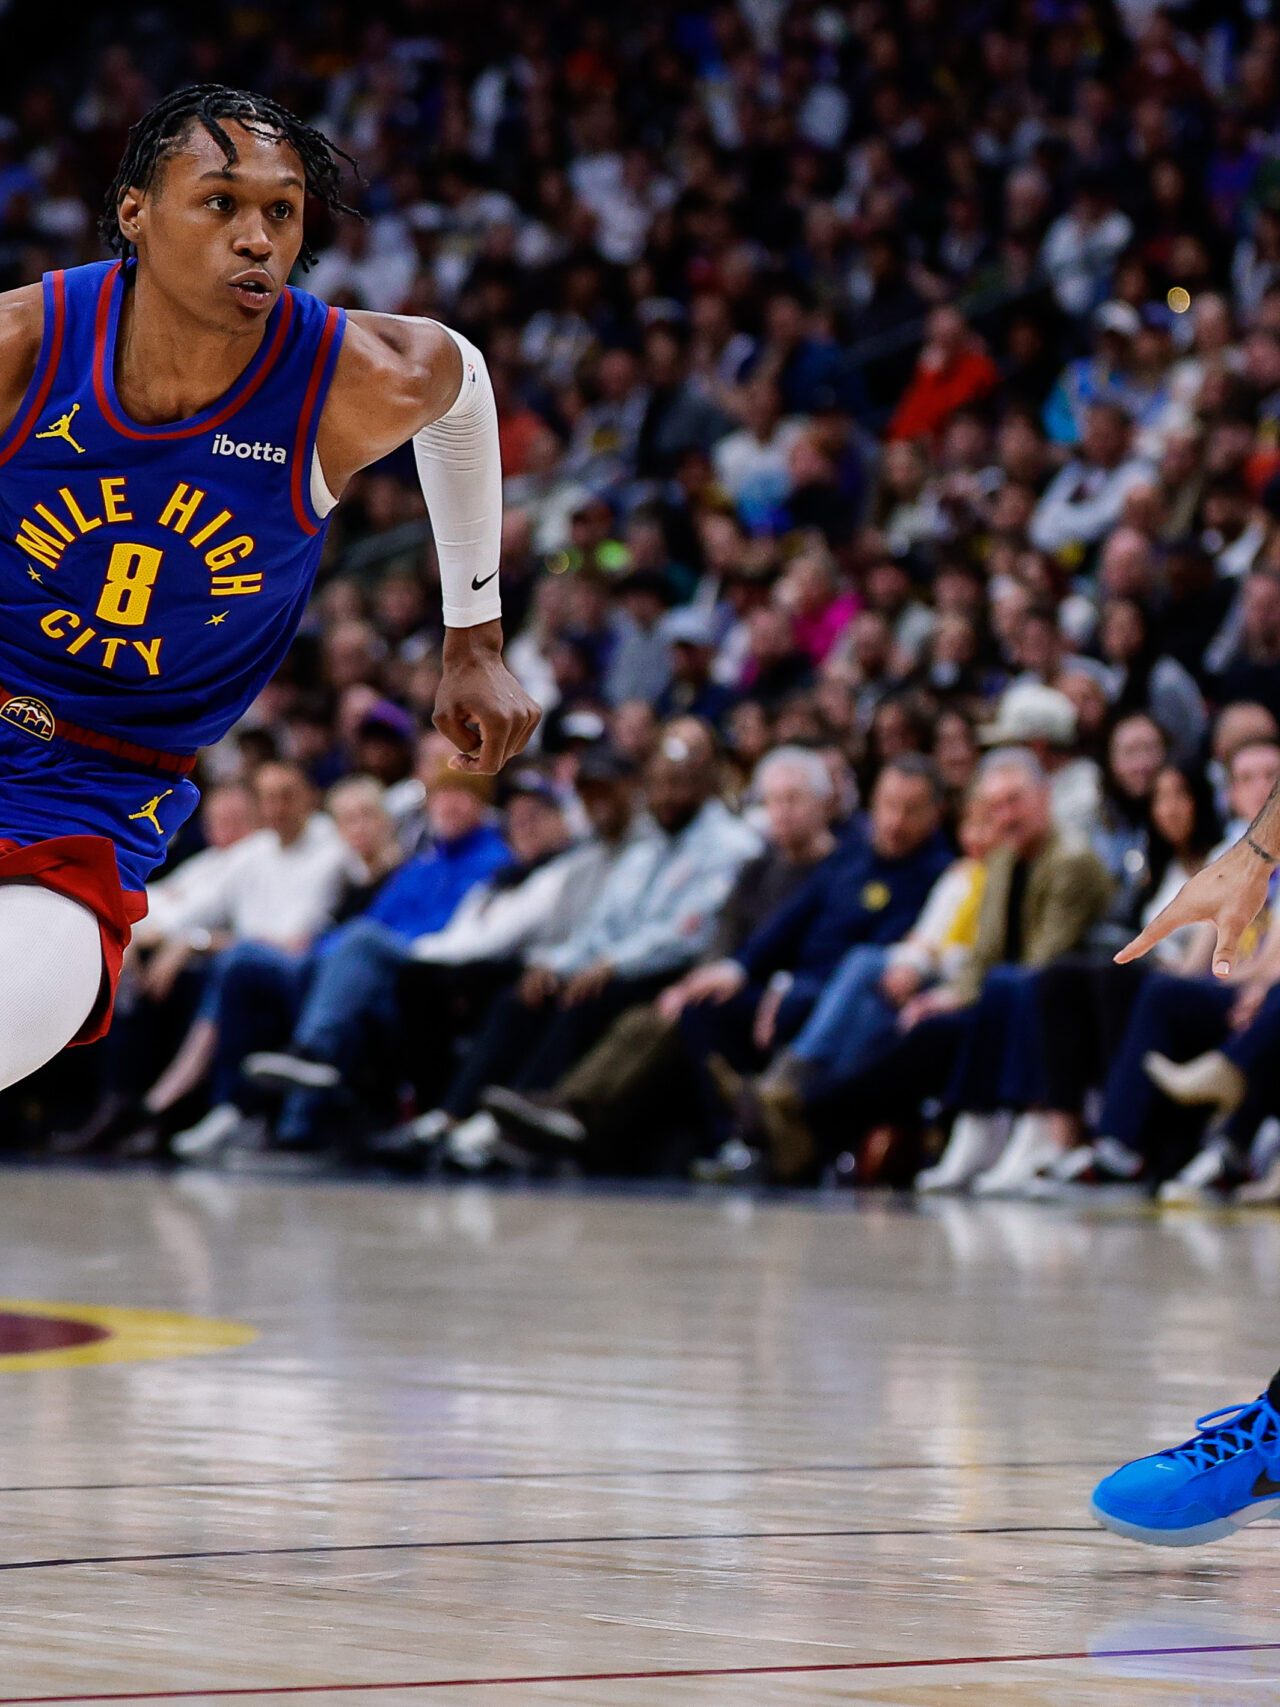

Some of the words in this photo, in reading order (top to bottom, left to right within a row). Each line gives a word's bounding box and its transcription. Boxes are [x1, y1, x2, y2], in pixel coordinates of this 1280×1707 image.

[212, 434, 287, 464] ibotta
[15, 477, 133, 570] MILE
[158, 482, 264, 596] HIGH
[96, 542, 164, 626] 8
[40, 609, 162, 676] CITY
